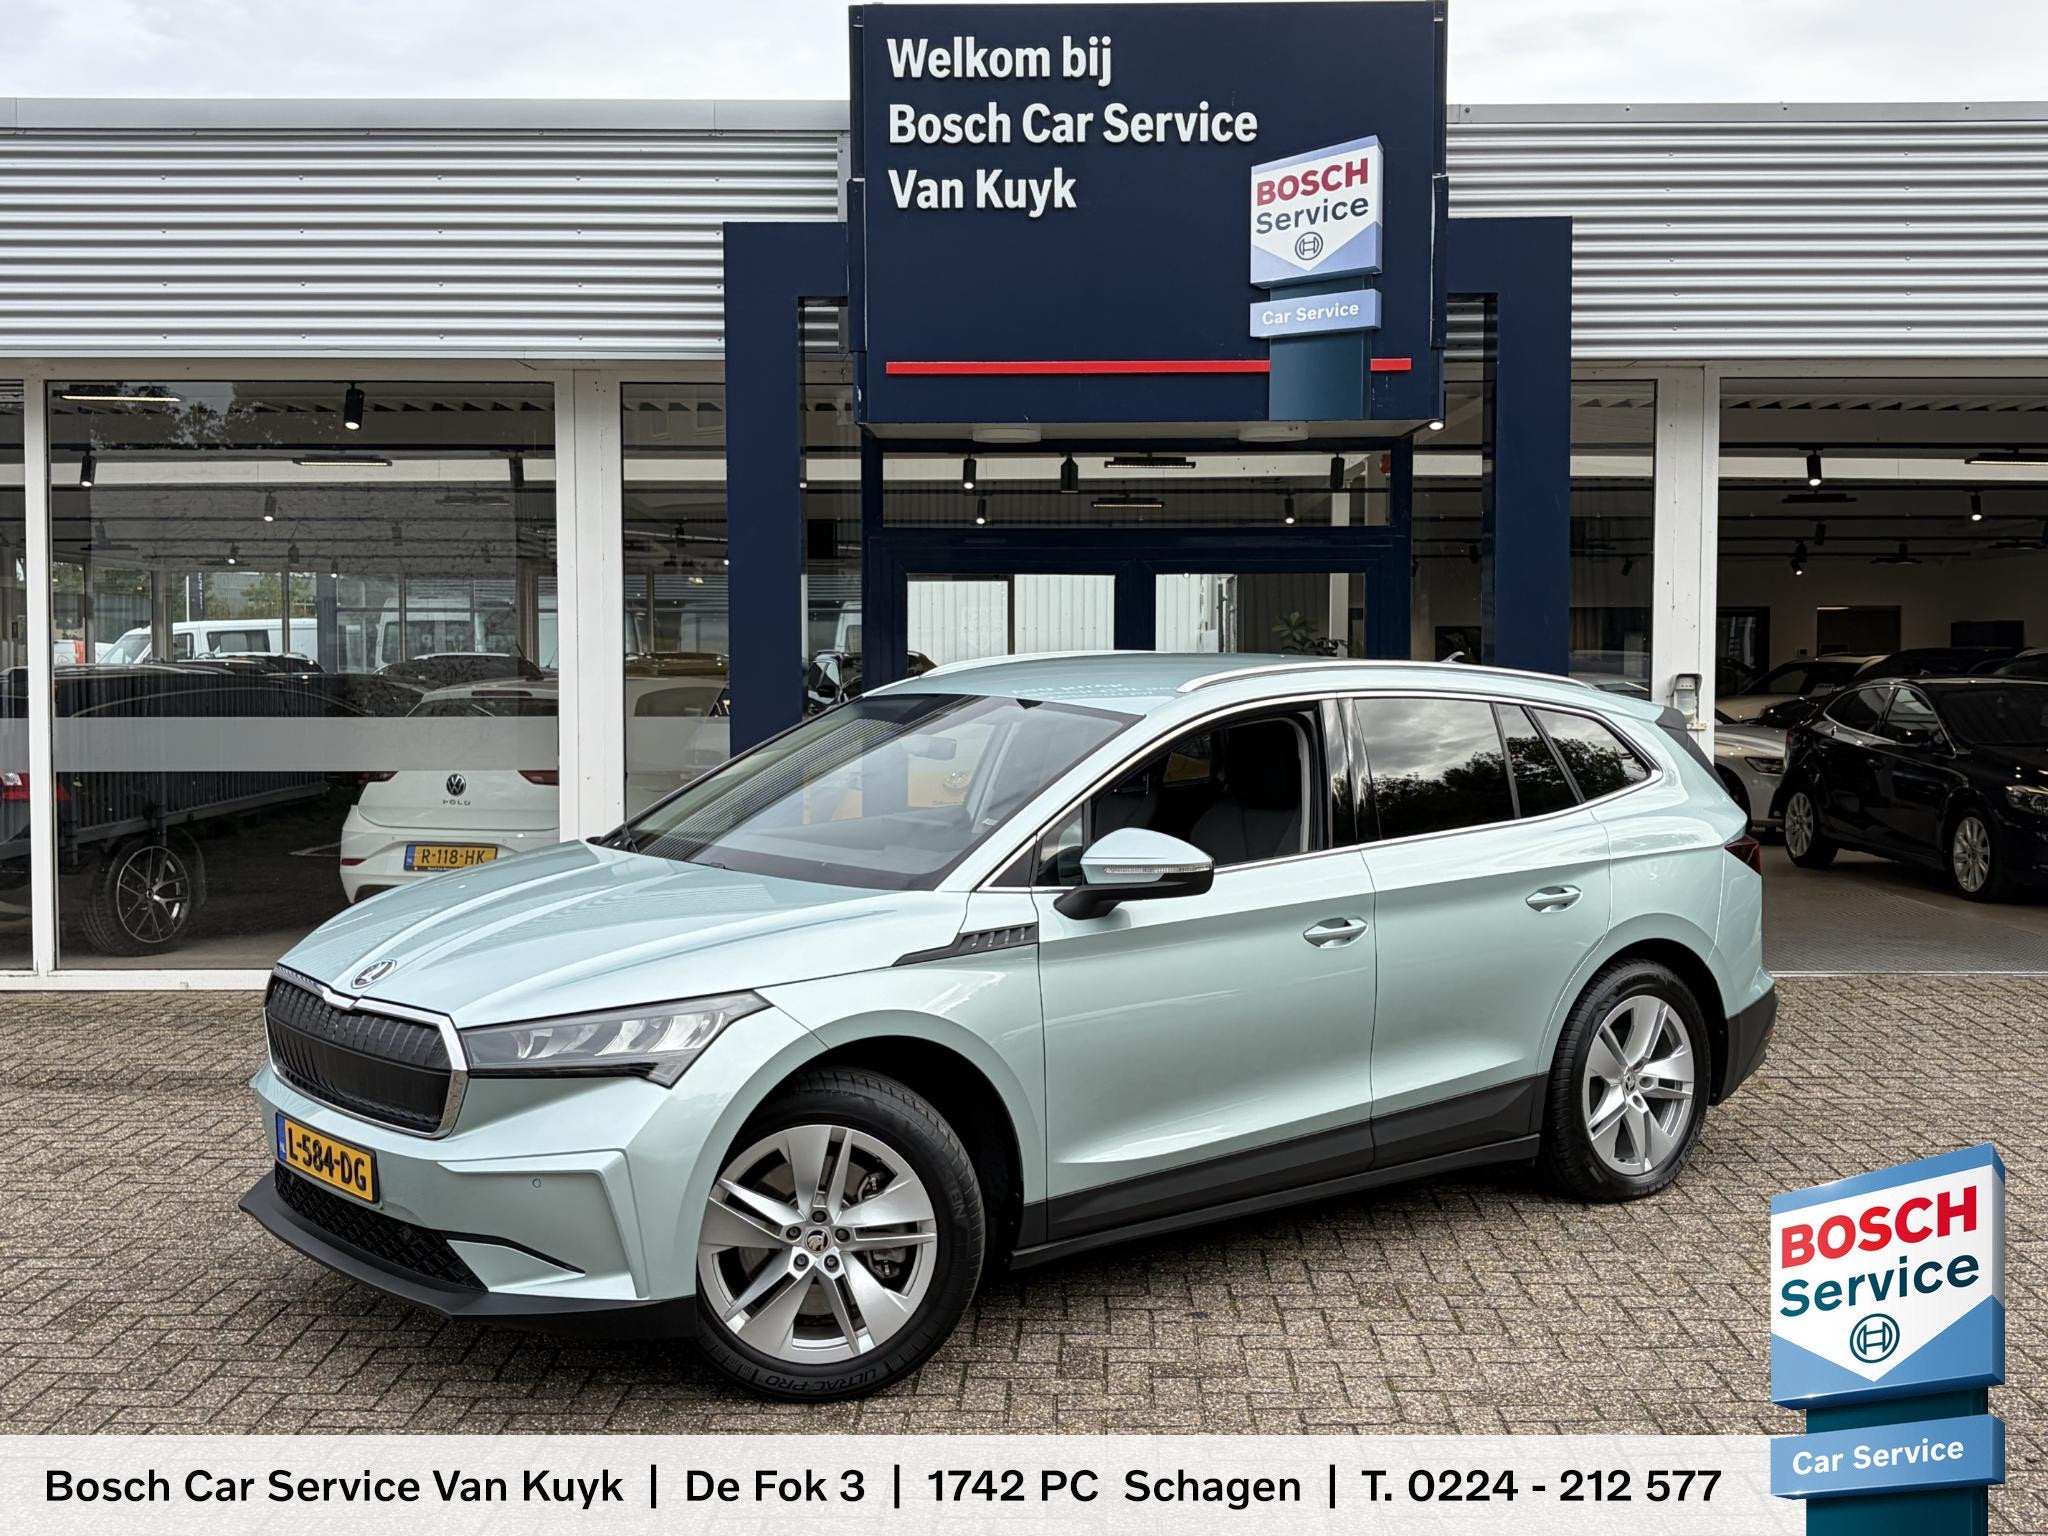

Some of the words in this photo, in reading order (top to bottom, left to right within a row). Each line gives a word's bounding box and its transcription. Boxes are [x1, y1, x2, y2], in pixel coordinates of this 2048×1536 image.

[887, 37, 1051, 79] Welkom
[1062, 36, 1112, 87] bij
[889, 101, 1011, 144] Bosch
[1022, 102, 1094, 143] Car
[1102, 100, 1258, 143] Service
[887, 169, 964, 209] Van
[976, 166, 1077, 218] Kuyk
[1256, 157, 1369, 206] BOSCH
[1256, 197, 1369, 235] Service
[1262, 310, 1291, 325] Car
[1296, 302, 1360, 322] Service
[420, 848, 486, 865] R-118-HK
[287, 1126, 367, 1192] L-584-DG
